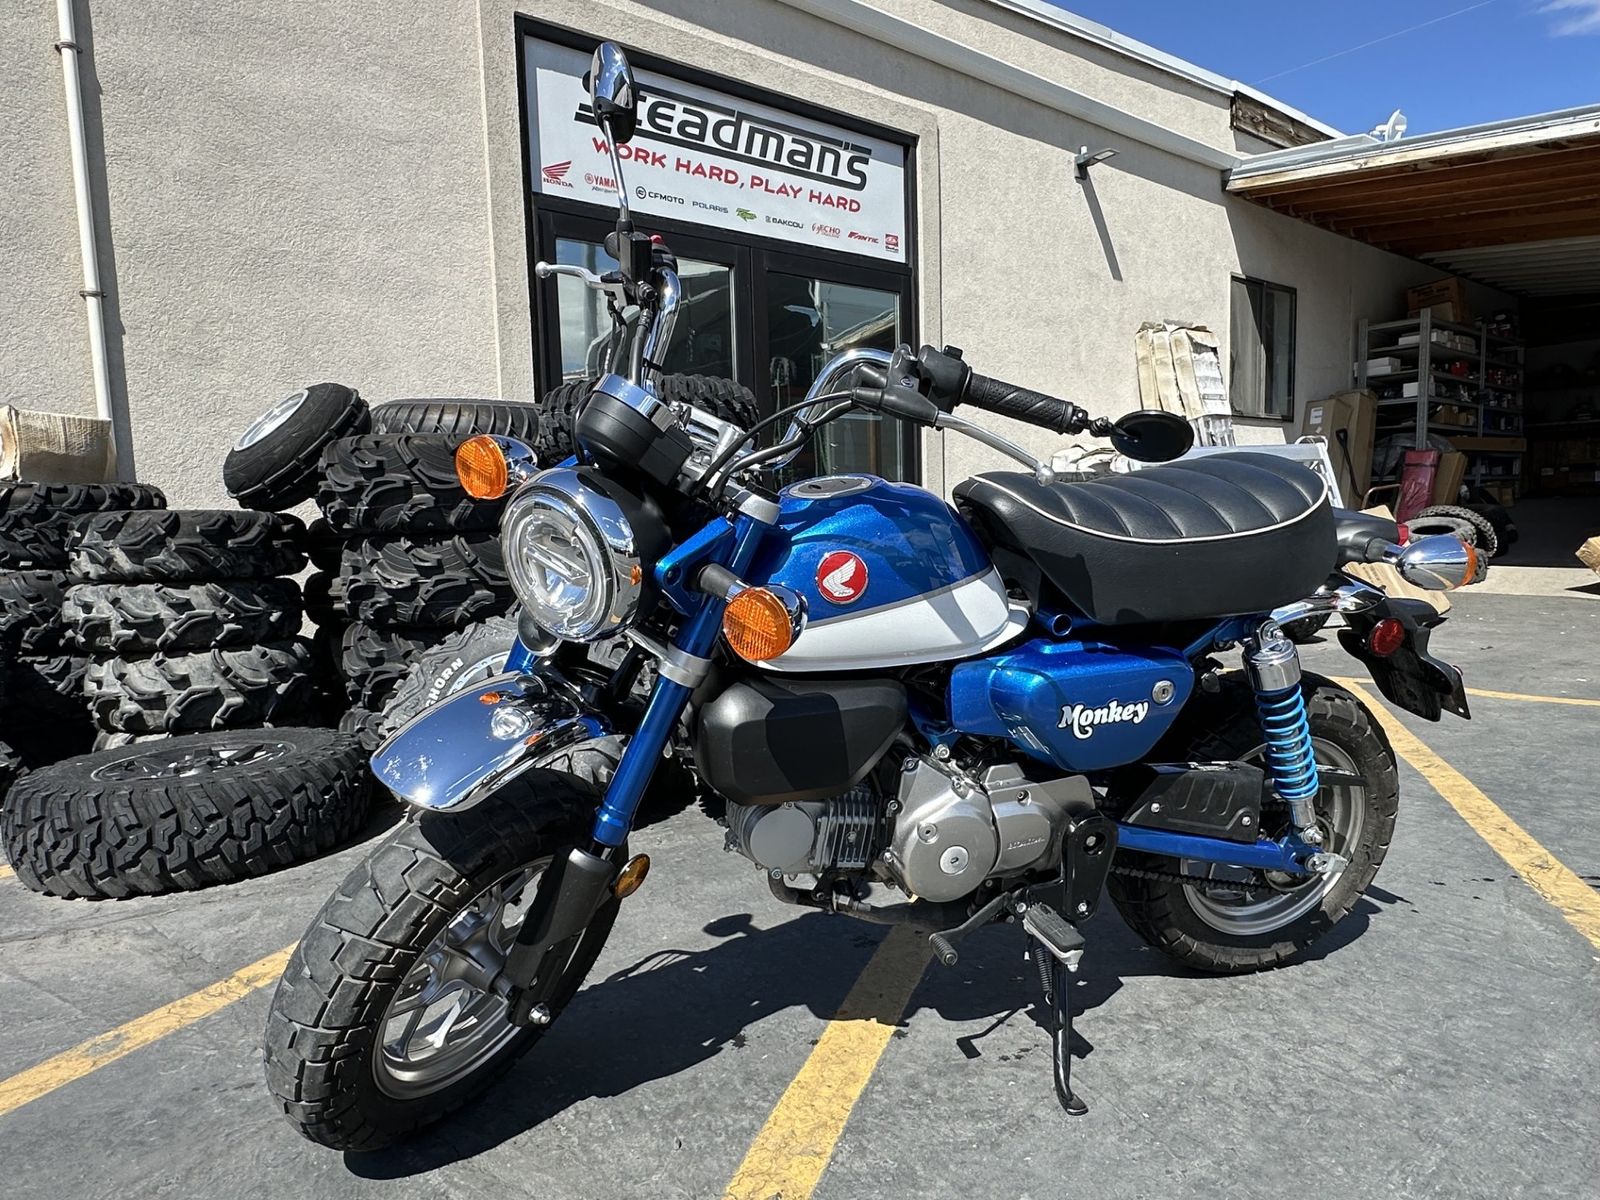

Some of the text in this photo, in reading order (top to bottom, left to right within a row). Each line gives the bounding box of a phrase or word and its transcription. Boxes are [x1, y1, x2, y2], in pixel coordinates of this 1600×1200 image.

[591, 136, 861, 213] WORK HARD, PLAY HARD
[593, 174, 618, 188] YAMA
[543, 177, 574, 188] HONDA
[648, 191, 685, 205] CFMOTO
[692, 200, 729, 214] POLARIS
[820, 224, 841, 235] ECHO
[1057, 700, 1149, 740] Monkey
